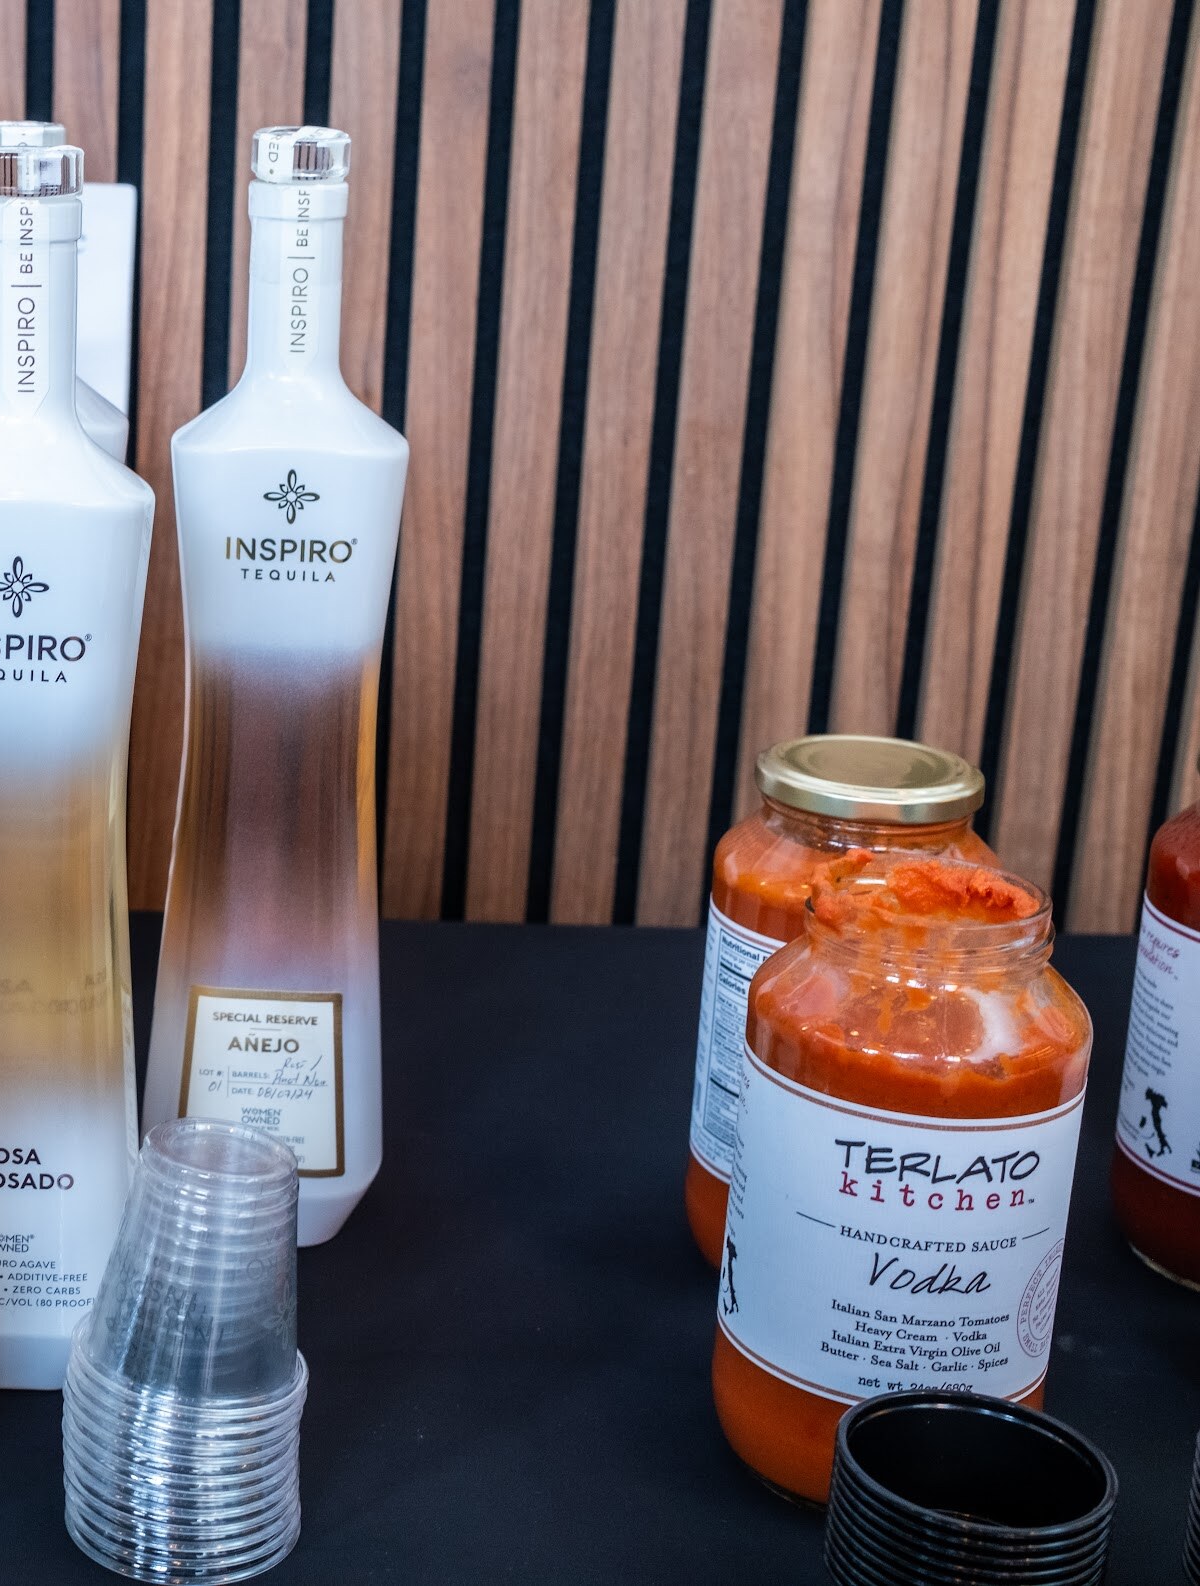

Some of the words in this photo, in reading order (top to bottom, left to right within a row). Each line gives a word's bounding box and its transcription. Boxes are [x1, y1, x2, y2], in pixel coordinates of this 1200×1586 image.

[296, 228, 308, 247] BE
[20, 252, 33, 274] BE
[290, 267, 309, 353] INSPIRO
[17, 297, 36, 394] INSPIRO
[241, 568, 335, 582] TEQUILA
[722, 936, 760, 961] Nutritional
[213, 1011, 261, 1024] SPECIAL
[266, 1014, 318, 1026] RESERVE
[227, 1033, 300, 1054] AÑEJO
[835, 1138, 1040, 1185] TERLATO
[840, 1225, 967, 1253] HANDCRAFTED
[971, 1237, 1017, 1253] SAUCE
[20, 1261, 56, 1269] AGAVE
[870, 1252, 991, 1296] Vodka
[7, 1272, 88, 1282] ADDITIVE-FREE
[12, 1285, 42, 1294] ZERO
[46, 1286, 81, 1295] CARBS
[36, 1298, 52, 1307] (80
[832, 1299, 870, 1318] Italian
[874, 1310, 897, 1323] San
[901, 1314, 956, 1328] Marzano
[959, 1313, 1010, 1327] Tomatoes
[854, 1321, 893, 1340] Heavy
[896, 1329, 938, 1342] Cream
[953, 1331, 987, 1342] Vodka
[832, 1330, 870, 1349] Italian
[874, 1341, 906, 1355] Extra
[909, 1345, 947, 1360] Virgin
[951, 1345, 981, 1357] Olive
[983, 1342, 1001, 1354] Oil
[820, 1341, 860, 1360] Butter
[870, 1355, 892, 1368] Sea
[895, 1358, 920, 1371] Salt
[931, 1361, 968, 1372] Garlic
[977, 1357, 1009, 1372] Spices
[858, 1375, 880, 1389] net
